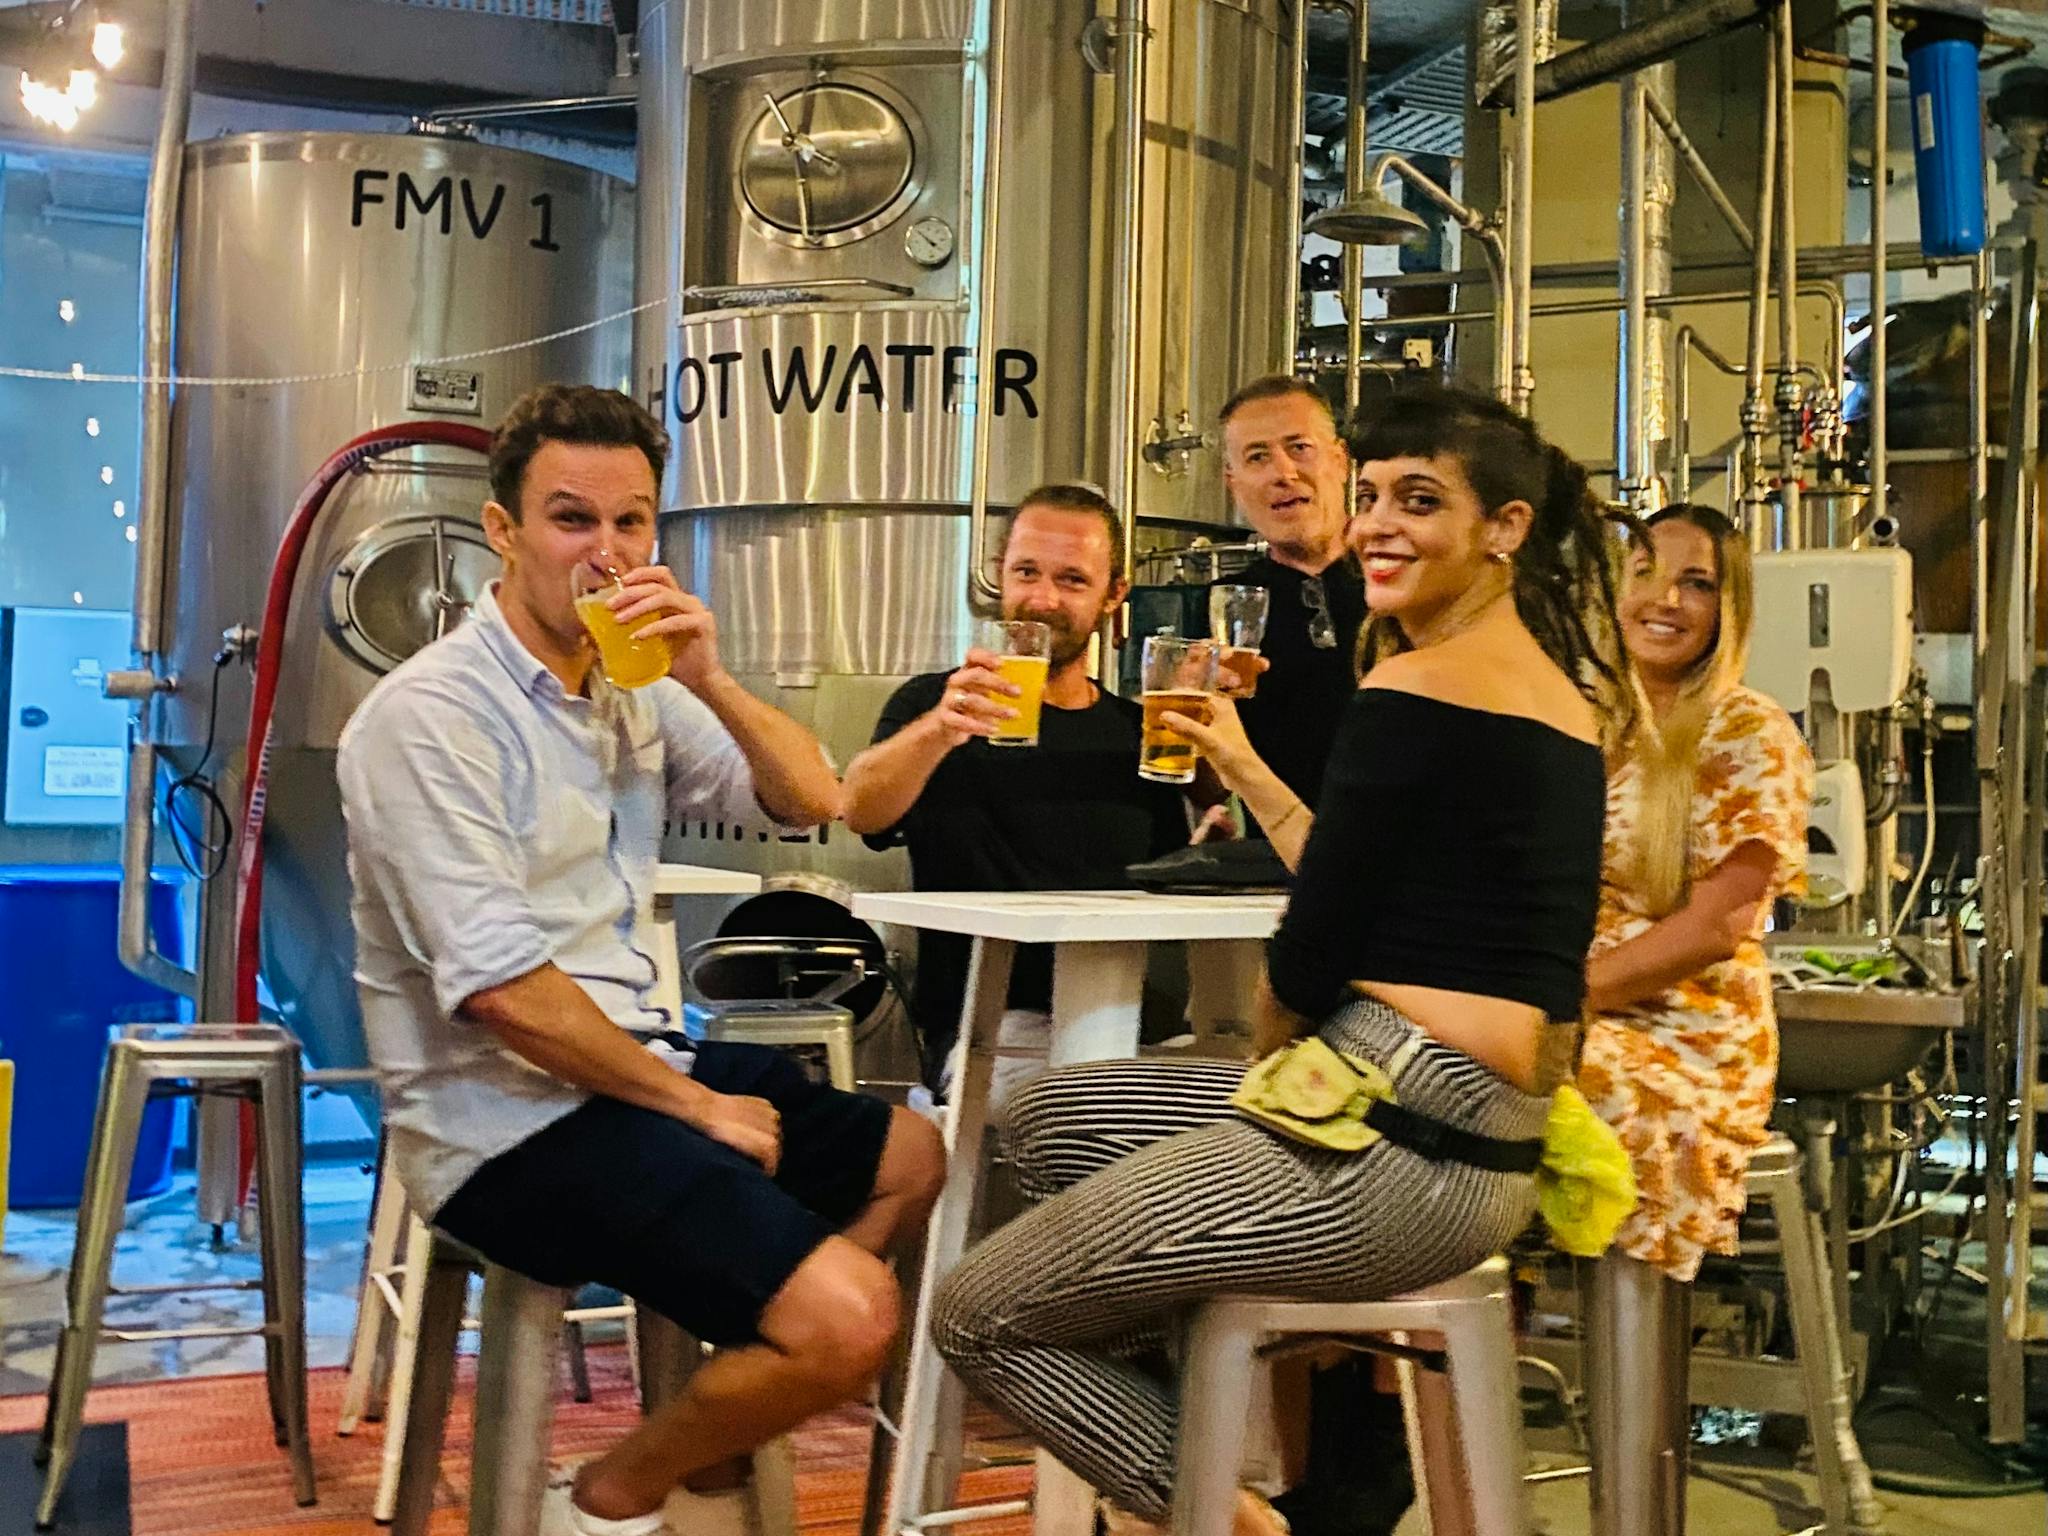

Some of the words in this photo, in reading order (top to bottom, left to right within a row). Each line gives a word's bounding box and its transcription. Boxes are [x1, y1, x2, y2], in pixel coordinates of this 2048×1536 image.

[352, 169, 506, 239] FMV
[529, 192, 560, 252] 1
[647, 352, 743, 427] HOT
[762, 344, 1039, 418] WATER
